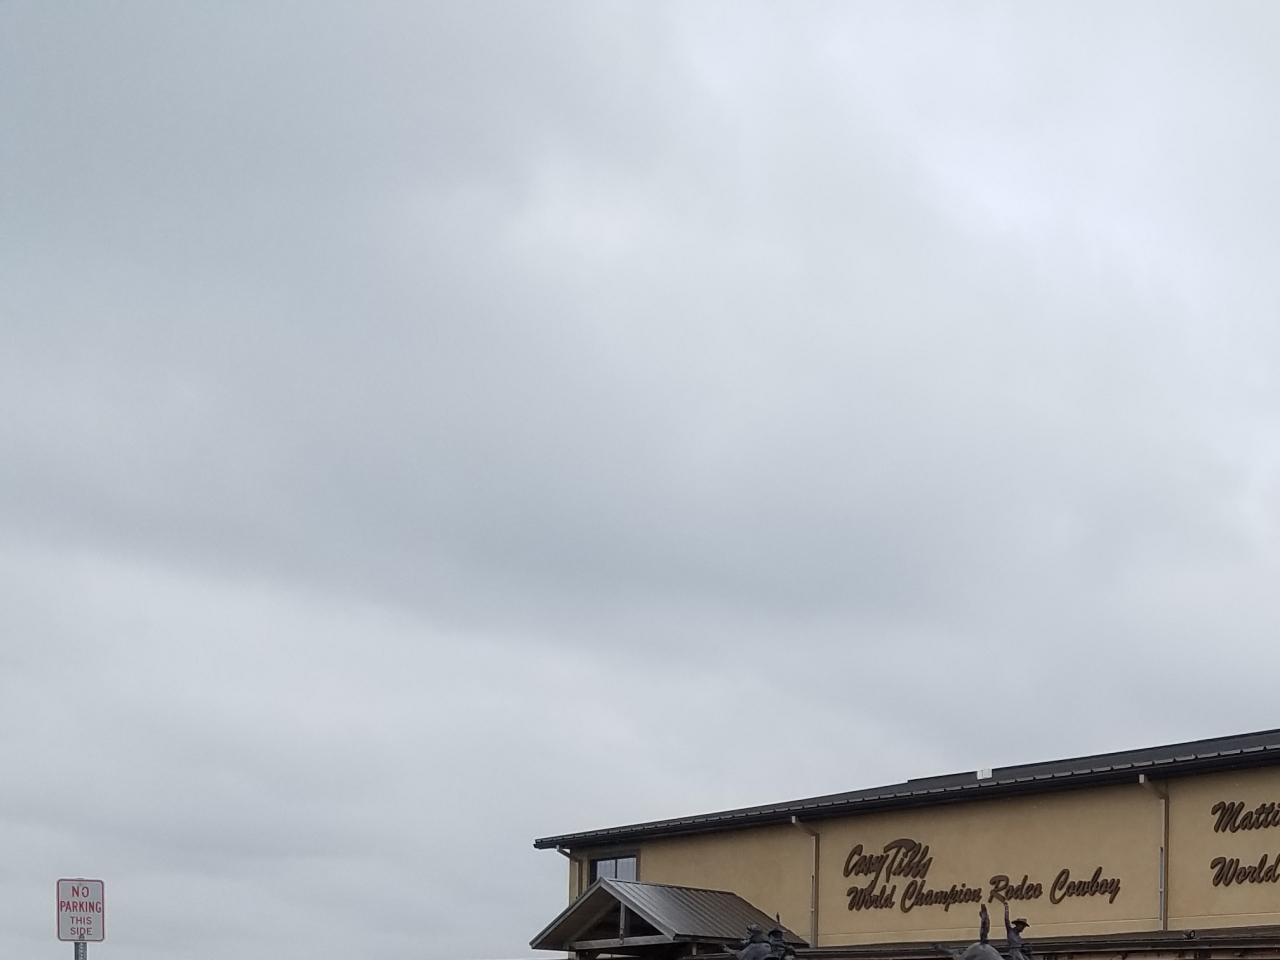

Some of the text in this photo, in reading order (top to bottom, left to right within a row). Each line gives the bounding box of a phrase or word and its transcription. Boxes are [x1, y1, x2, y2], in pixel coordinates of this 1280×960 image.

[71, 885, 90, 898] NO
[847, 866, 1121, 913] World Champion Rodeo Cowboy
[60, 900, 102, 913] PARKING
[70, 916, 92, 925] THIS
[70, 926, 93, 936] SIDE
